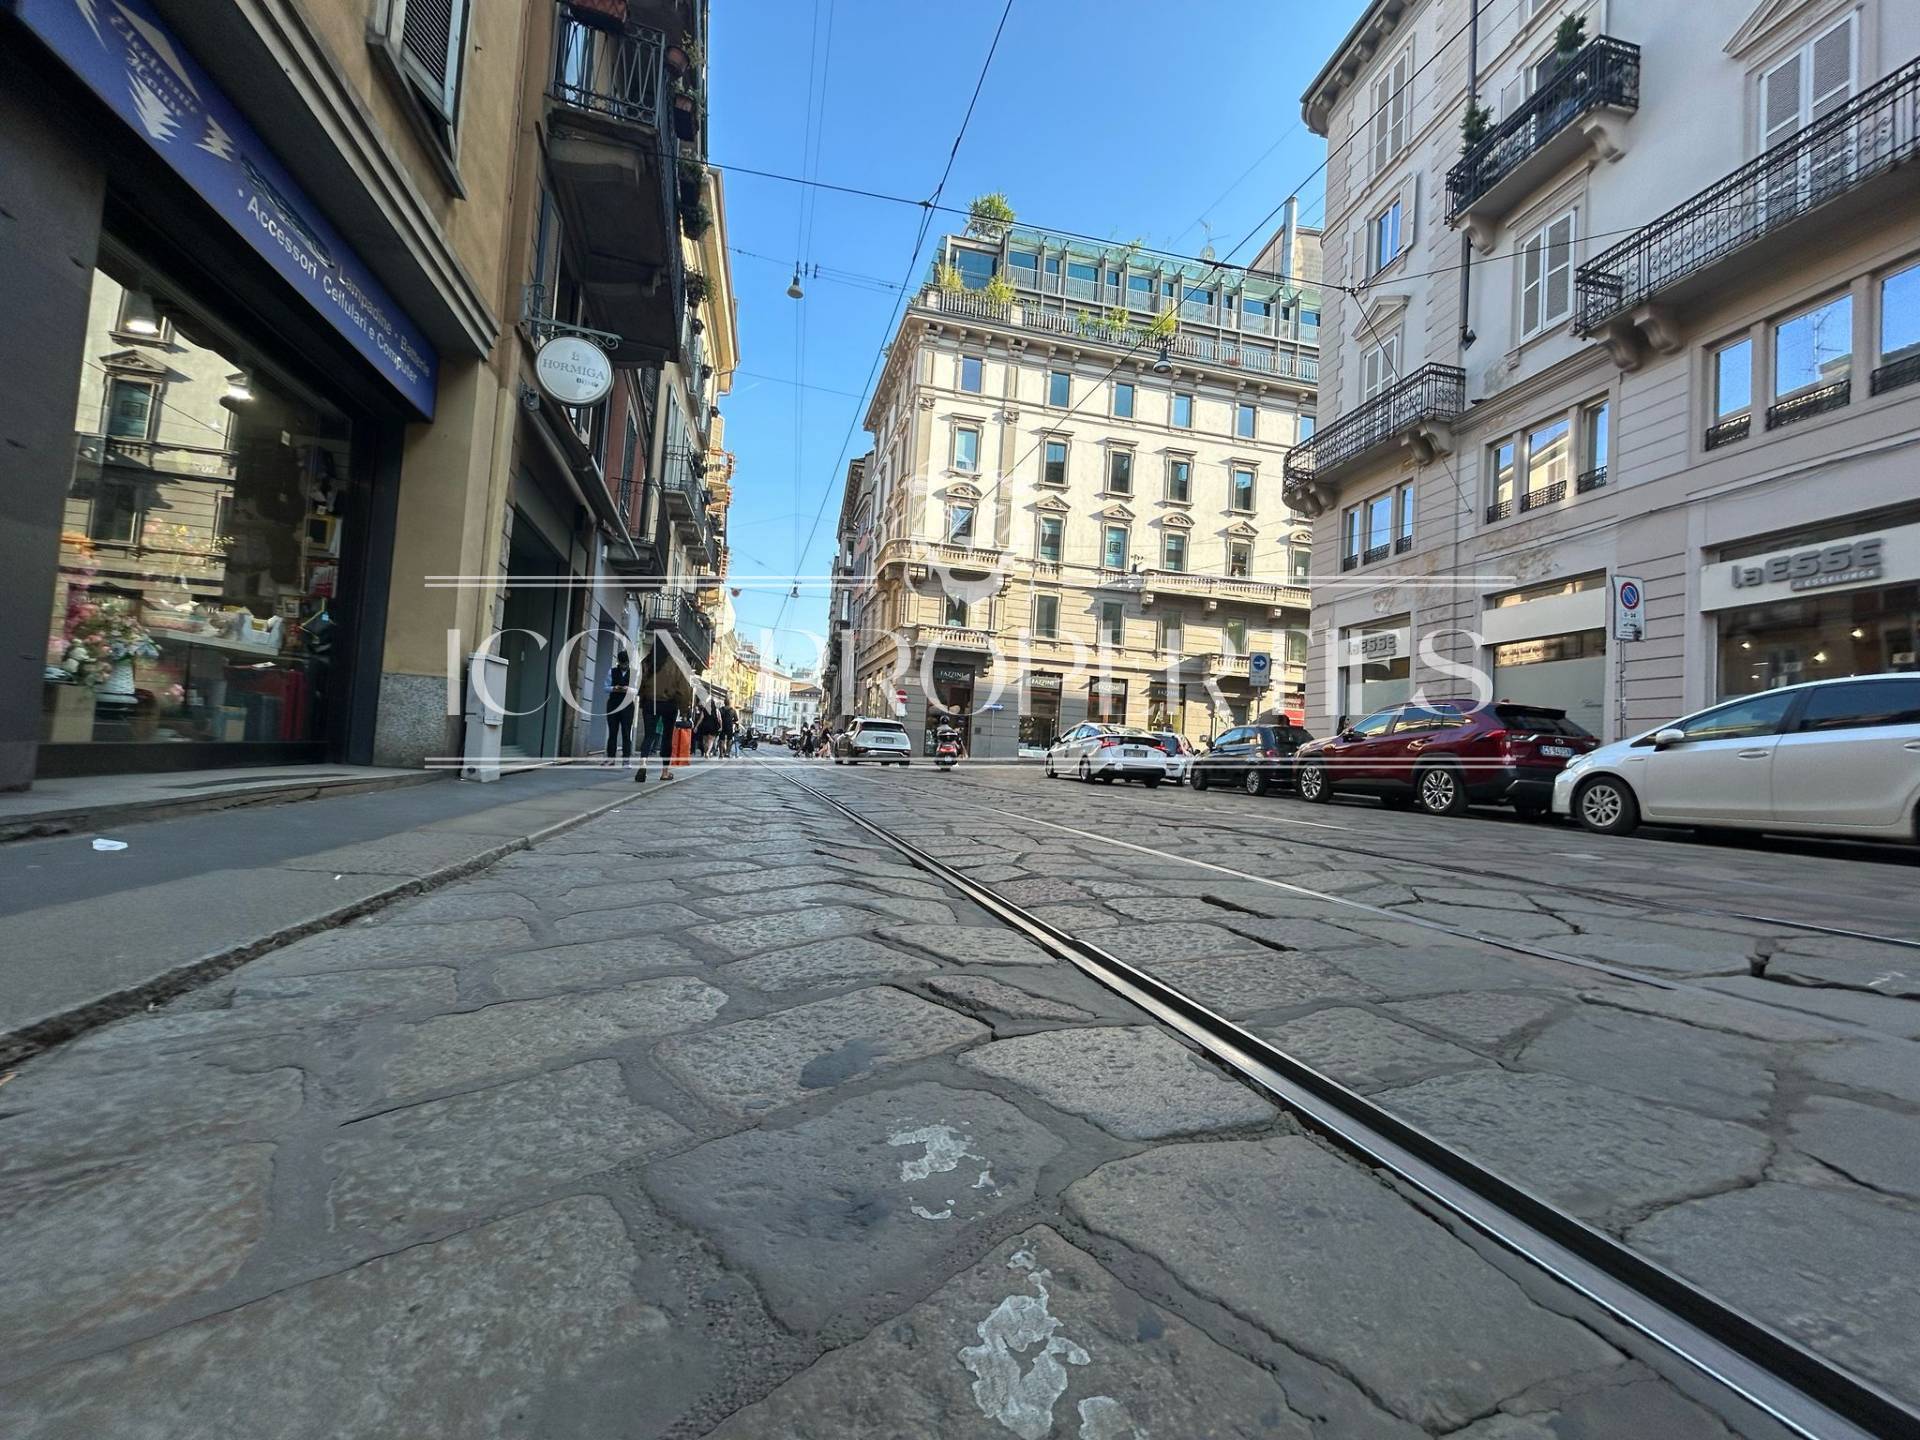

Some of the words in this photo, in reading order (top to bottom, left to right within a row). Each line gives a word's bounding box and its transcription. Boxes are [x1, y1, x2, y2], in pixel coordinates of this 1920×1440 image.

[247, 196, 318, 281] Accessori
[322, 275, 368, 333] Cellulari
[368, 327, 376, 340] e
[377, 332, 418, 384] Computer
[338, 264, 393, 336] Lampadine
[542, 358, 605, 380] HORMIGA
[940, 670, 965, 679] FAZZINI
